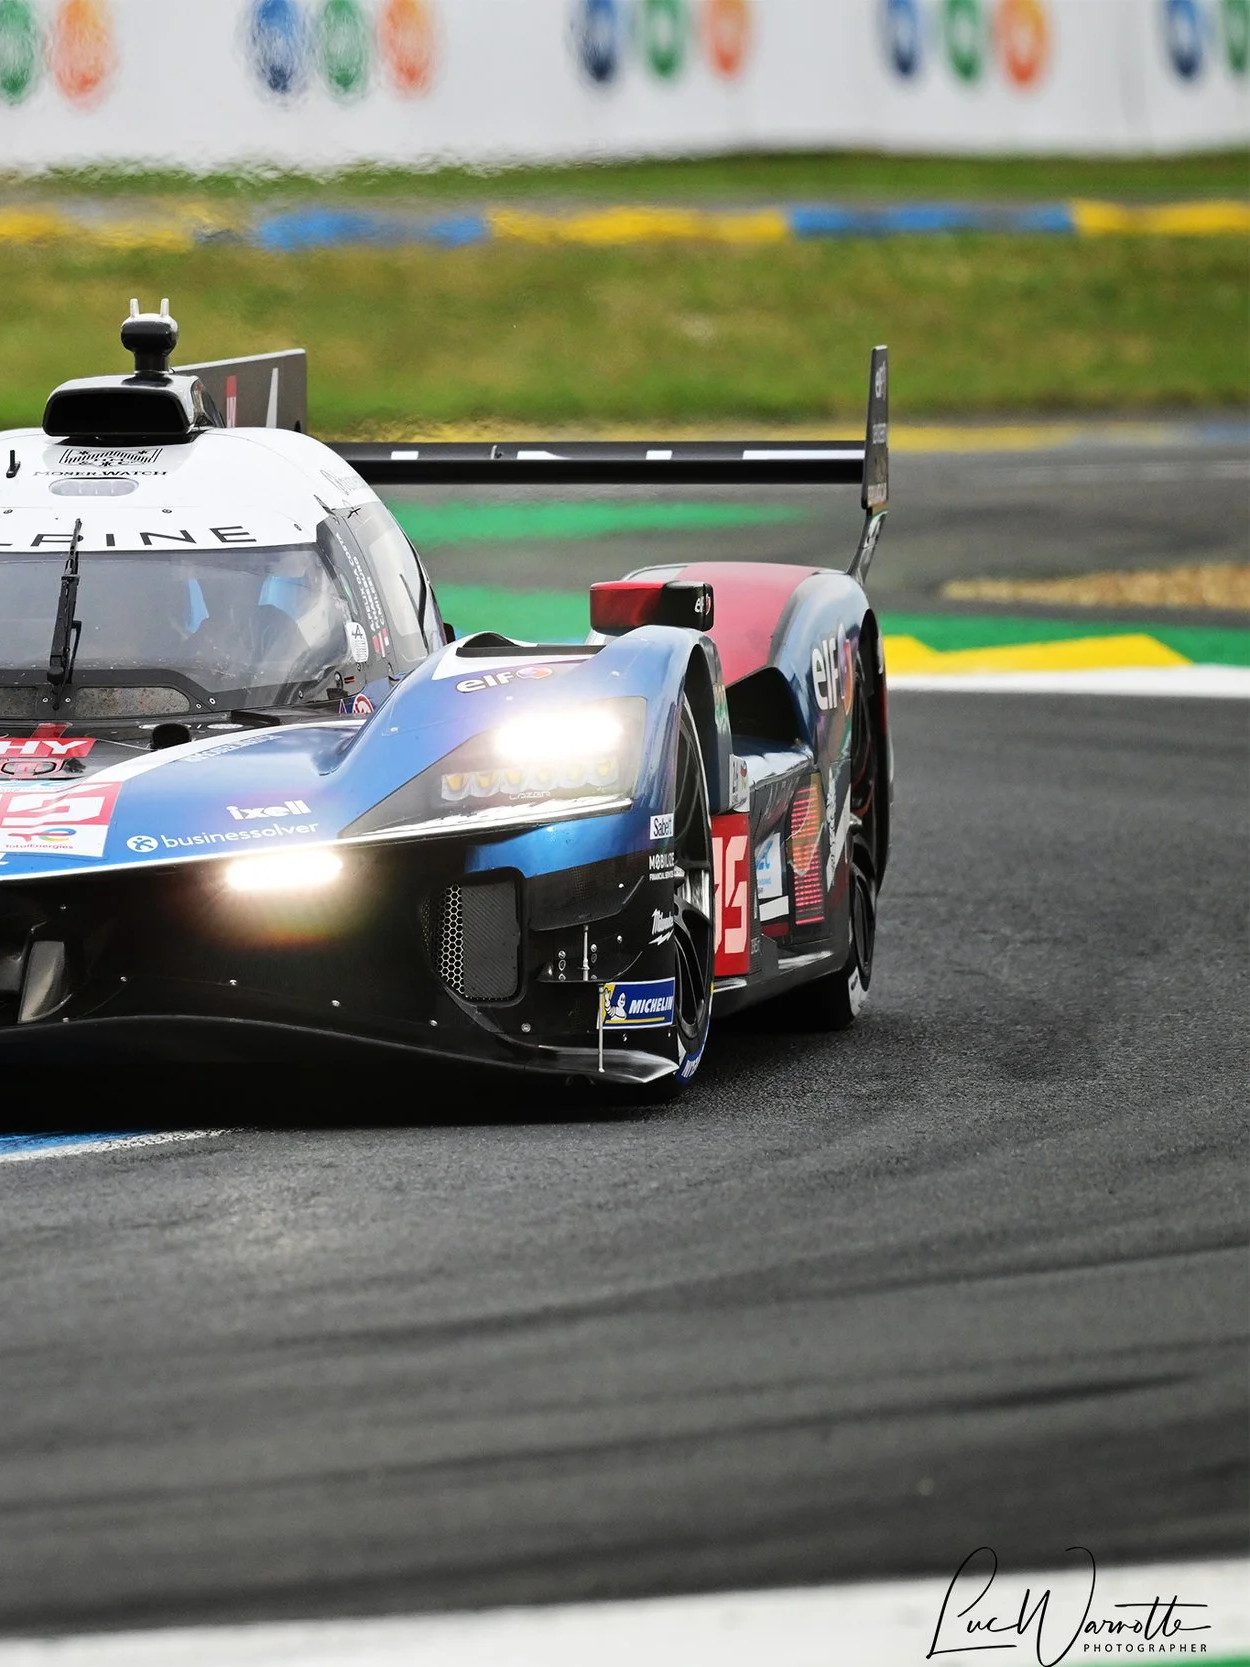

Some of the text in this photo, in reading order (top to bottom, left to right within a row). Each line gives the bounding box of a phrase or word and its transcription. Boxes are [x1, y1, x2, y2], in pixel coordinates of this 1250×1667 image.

[456, 671, 515, 693] elf
[812, 637, 839, 711] elf
[226, 800, 312, 820] ixell
[161, 822, 319, 849] businessolver
[628, 995, 674, 1014] MICHELIN
